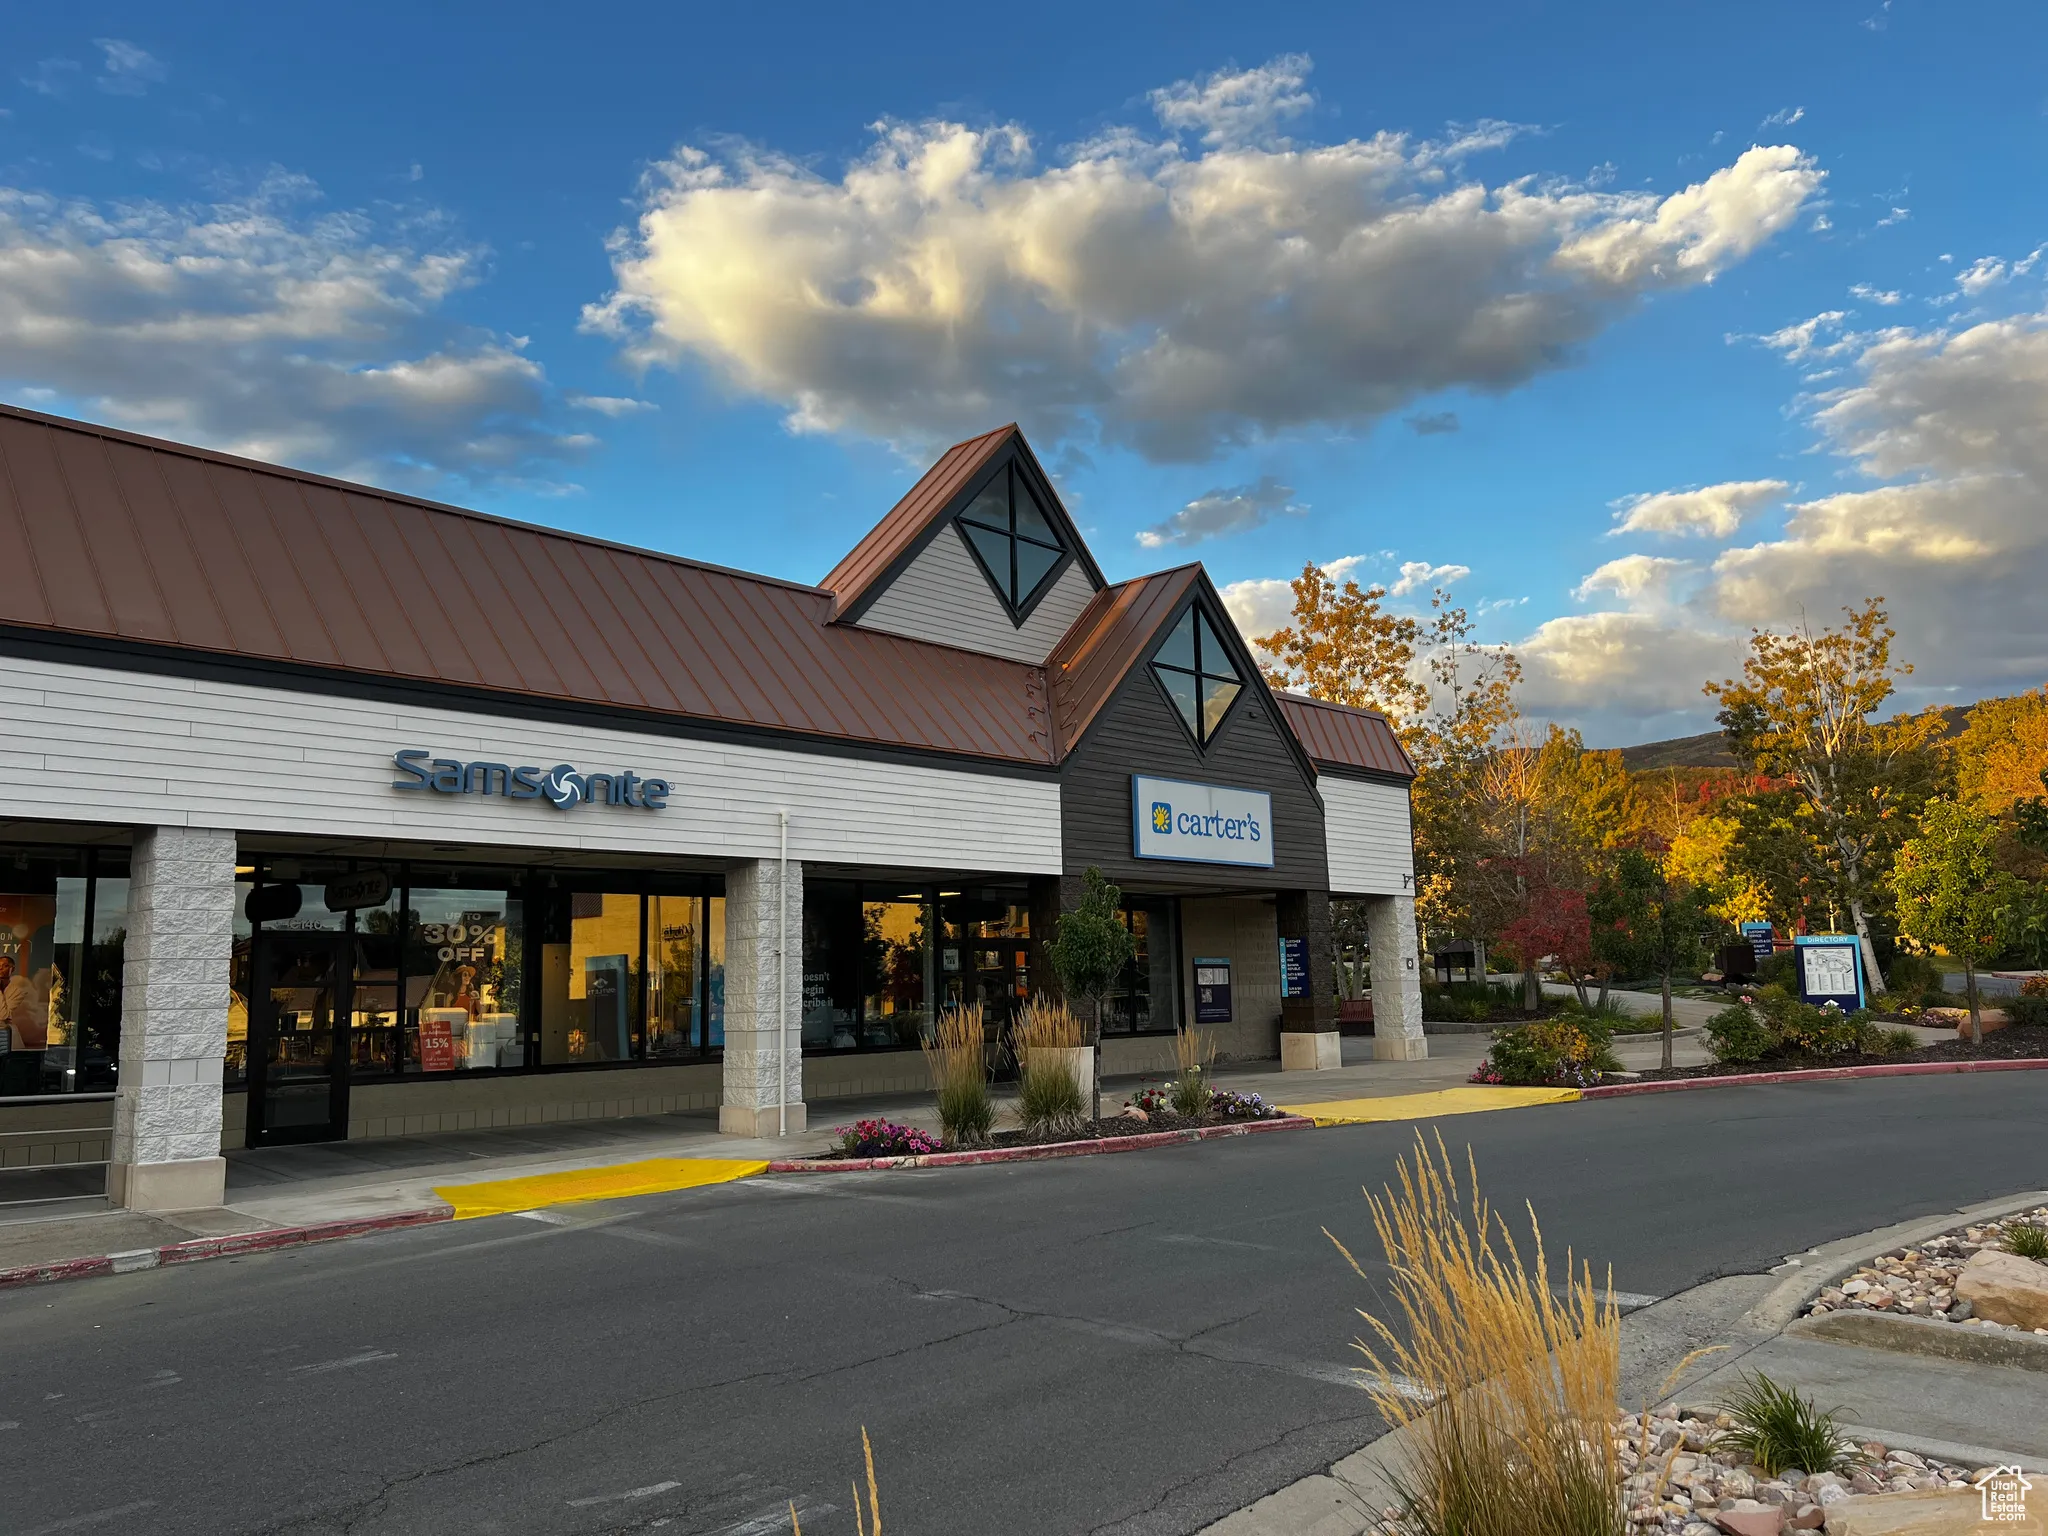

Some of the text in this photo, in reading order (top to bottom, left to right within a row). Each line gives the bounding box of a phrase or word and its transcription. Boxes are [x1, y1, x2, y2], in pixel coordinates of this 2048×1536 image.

[391, 749, 669, 810] Samsonite
[1177, 809, 1261, 842] carter's
[444, 911, 481, 920] UP TO
[424, 924, 498, 945] 30%
[437, 946, 484, 962] OFF
[804, 971, 830, 981] oesn't
[803, 997, 826, 1008] cribe
[425, 1037, 449, 1049] 15%
